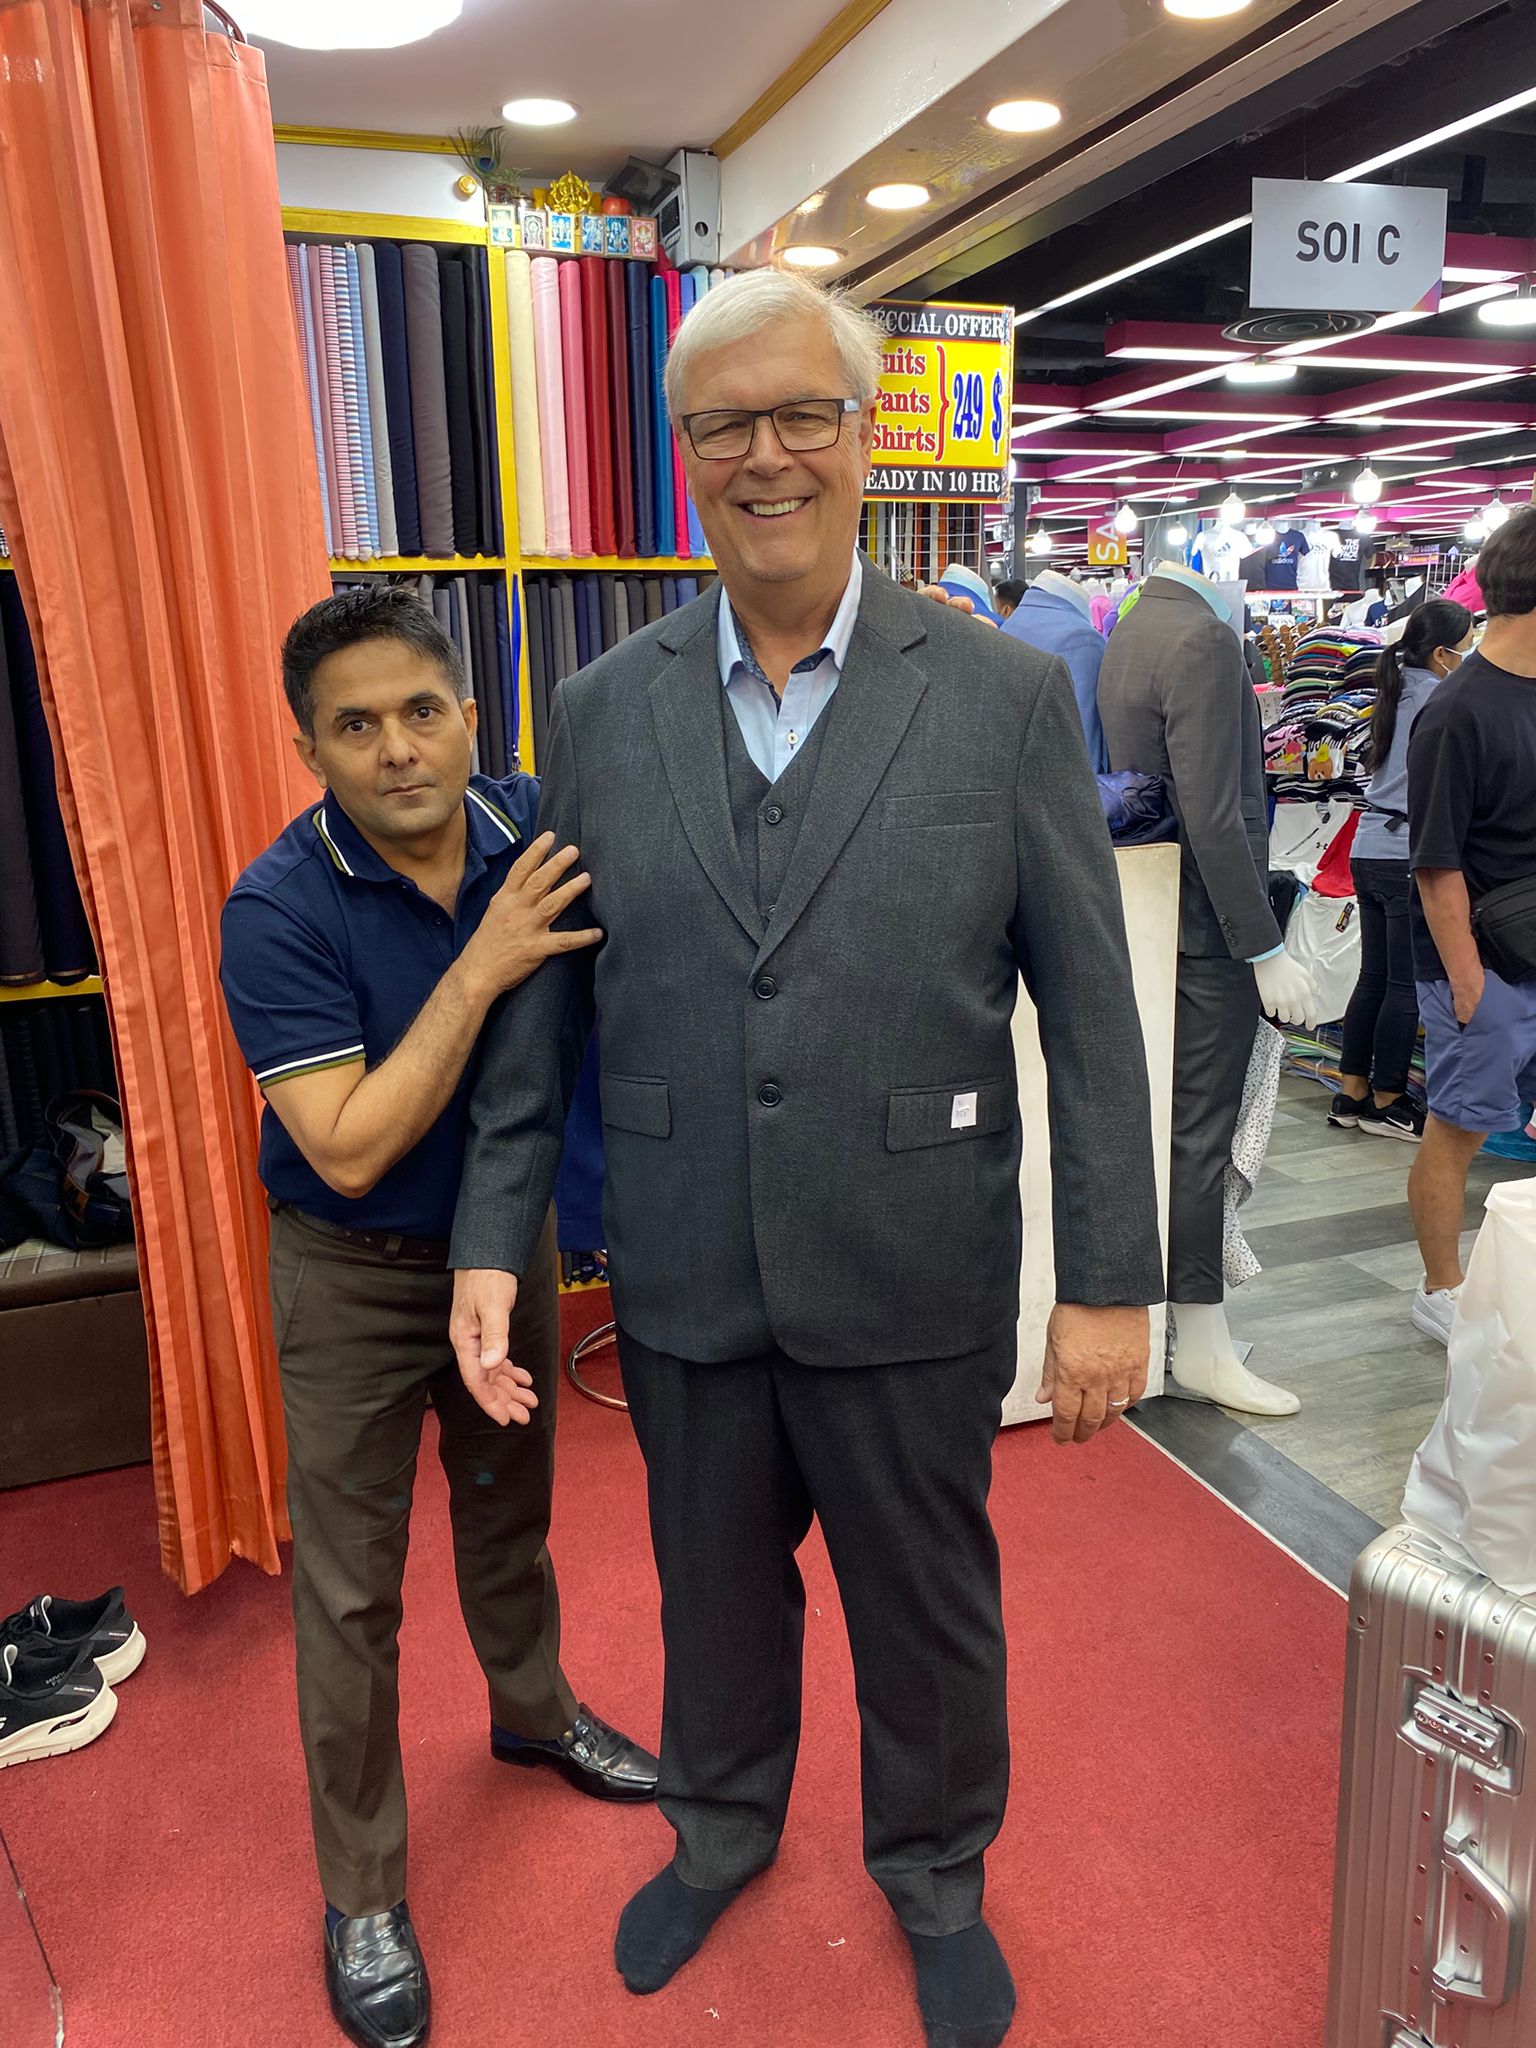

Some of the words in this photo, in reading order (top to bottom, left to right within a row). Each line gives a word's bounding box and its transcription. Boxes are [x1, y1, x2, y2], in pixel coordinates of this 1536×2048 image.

[1295, 219, 1361, 264] SOI
[1377, 224, 1401, 266] C
[944, 313, 1005, 338] OFFER
[882, 347, 926, 375] uits
[953, 372, 983, 440] 249
[991, 370, 1003, 454] $
[871, 424, 936, 452] Shirts
[863, 469, 919, 490] EADY
[922, 469, 945, 491] IN
[948, 471, 968, 492] 10
[971, 472, 1001, 493] HR
